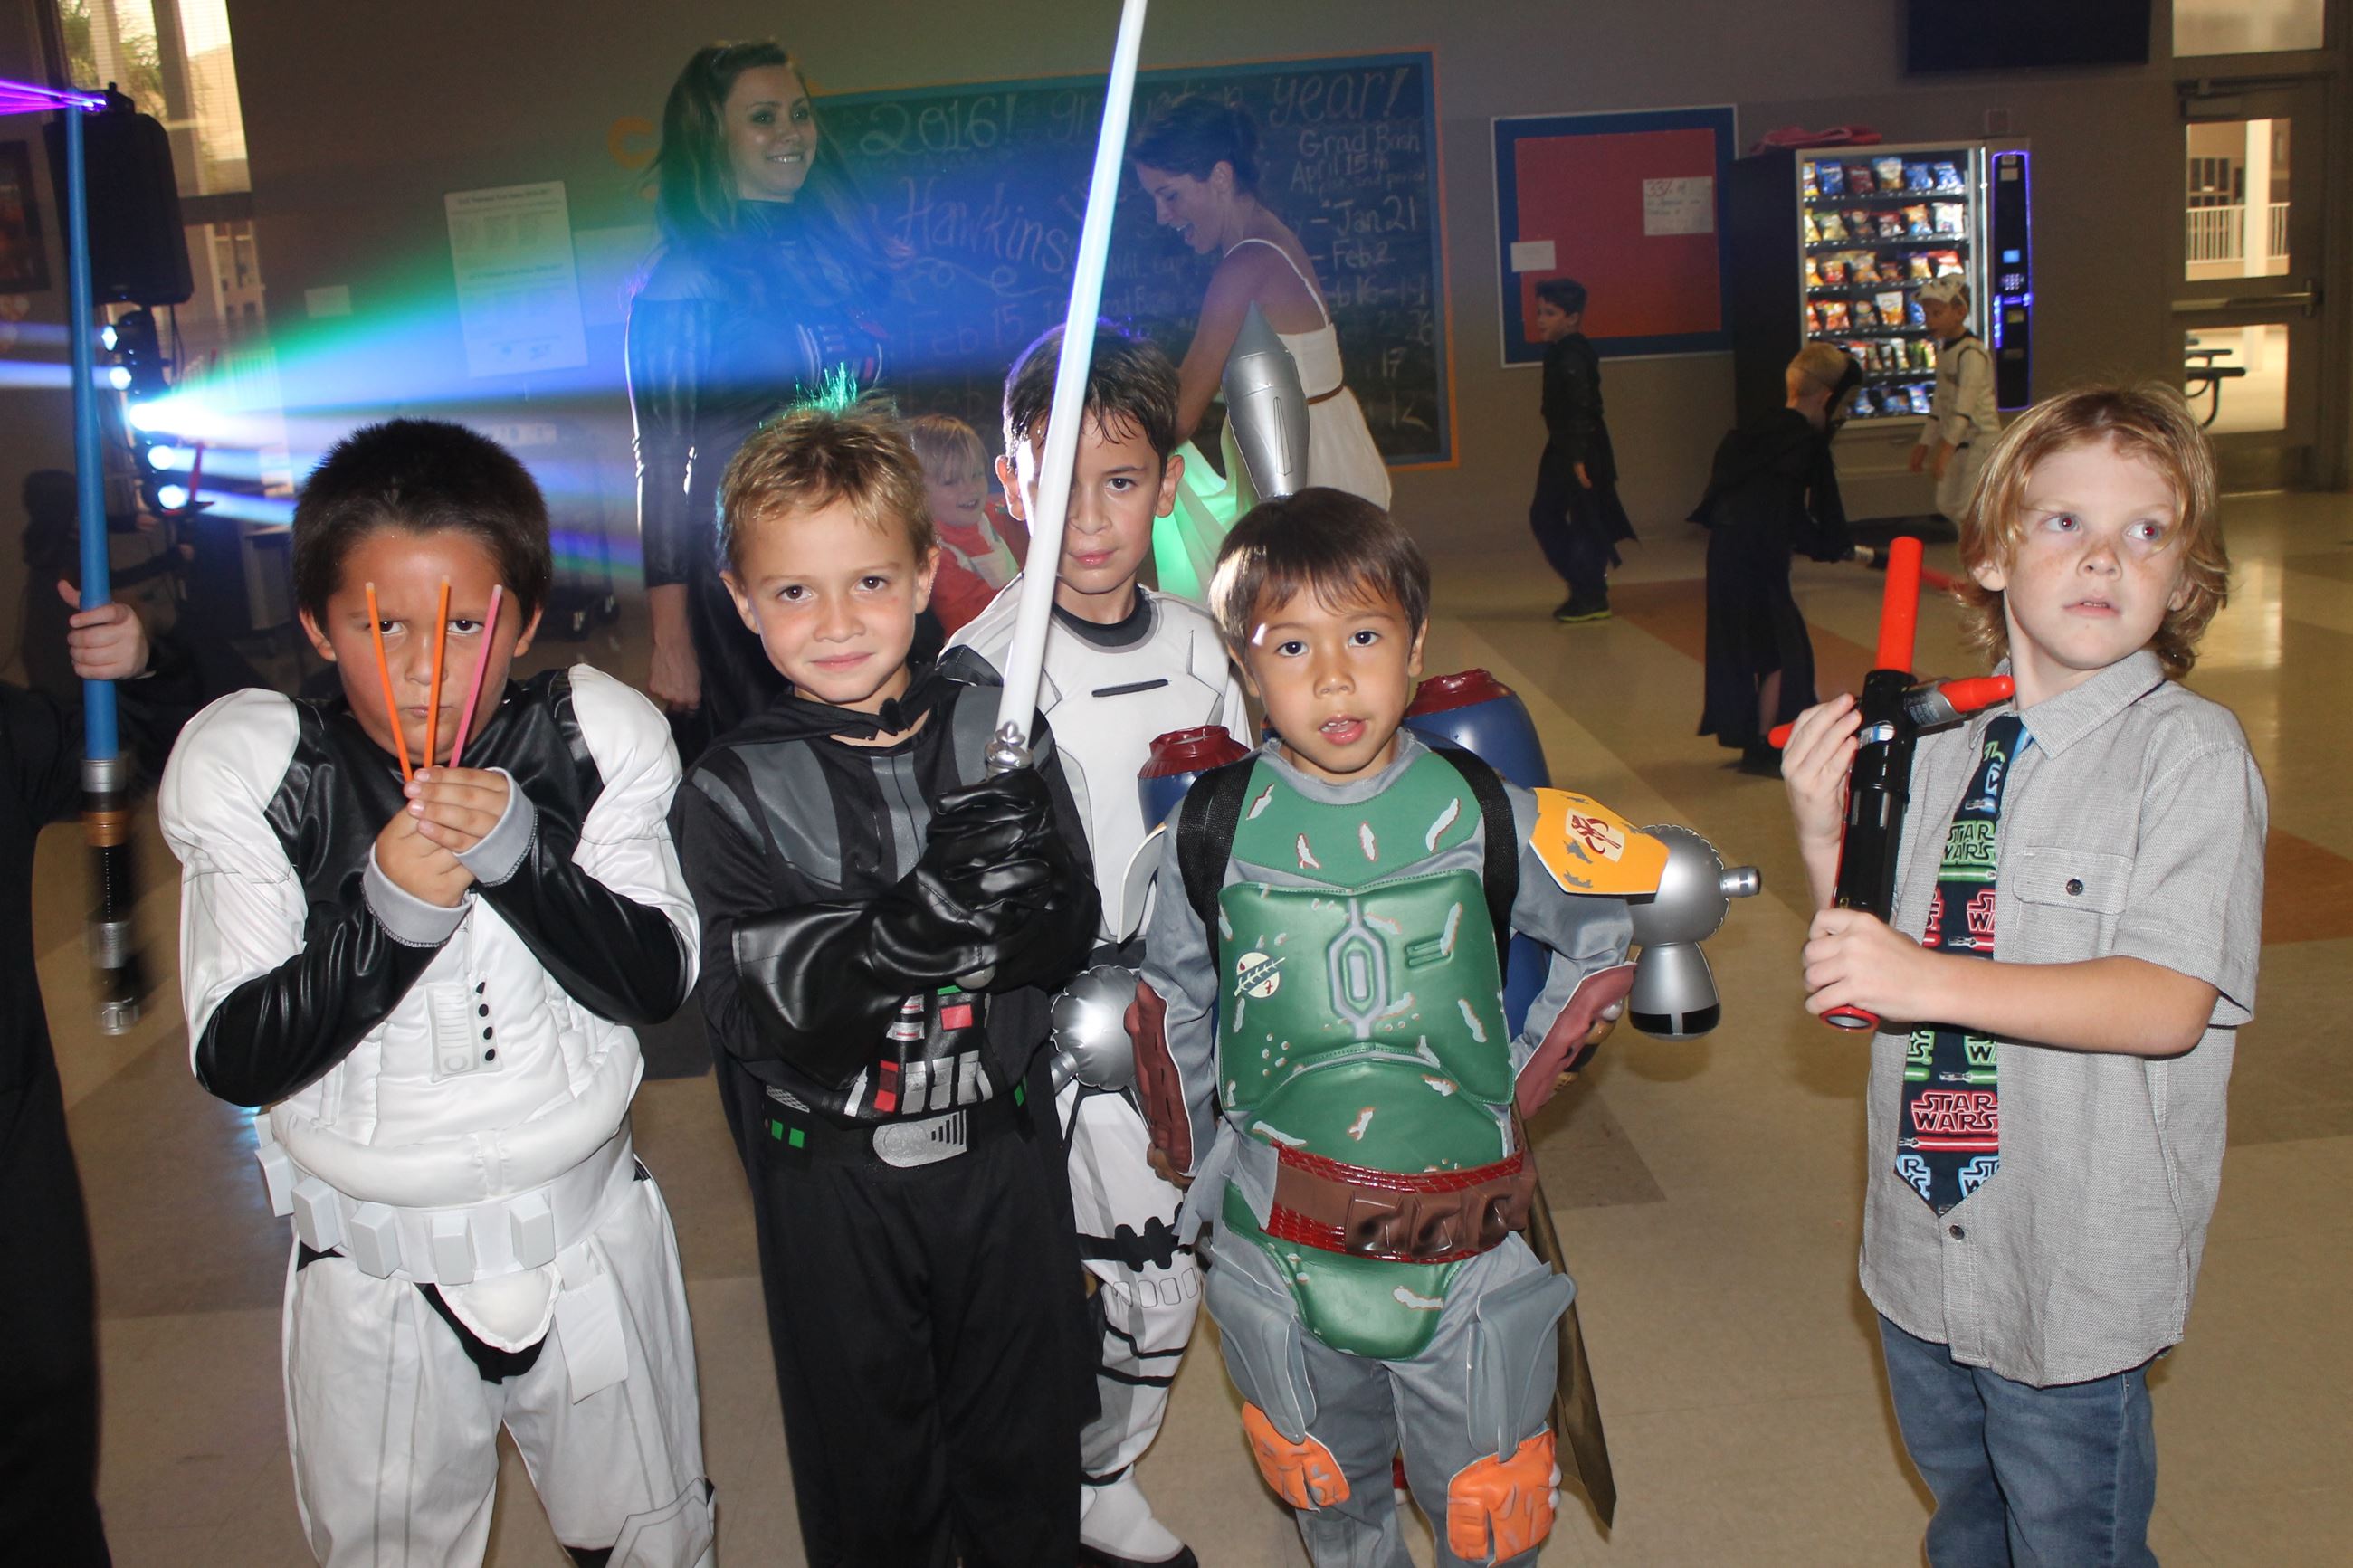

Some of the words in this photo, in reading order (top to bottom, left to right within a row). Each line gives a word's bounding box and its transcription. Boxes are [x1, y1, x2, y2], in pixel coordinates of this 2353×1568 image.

[860, 94, 1017, 156] 2016!
[1269, 68, 1409, 128] year!
[1298, 124, 1367, 157] Grad
[1289, 152, 1340, 194] April
[895, 176, 1067, 272] Hawkins
[1332, 198, 1383, 237] Jan
[1946, 822, 1995, 841] STAR
[1911, 1093, 1998, 1112] STAR
[1911, 1112, 1998, 1131] WARS
